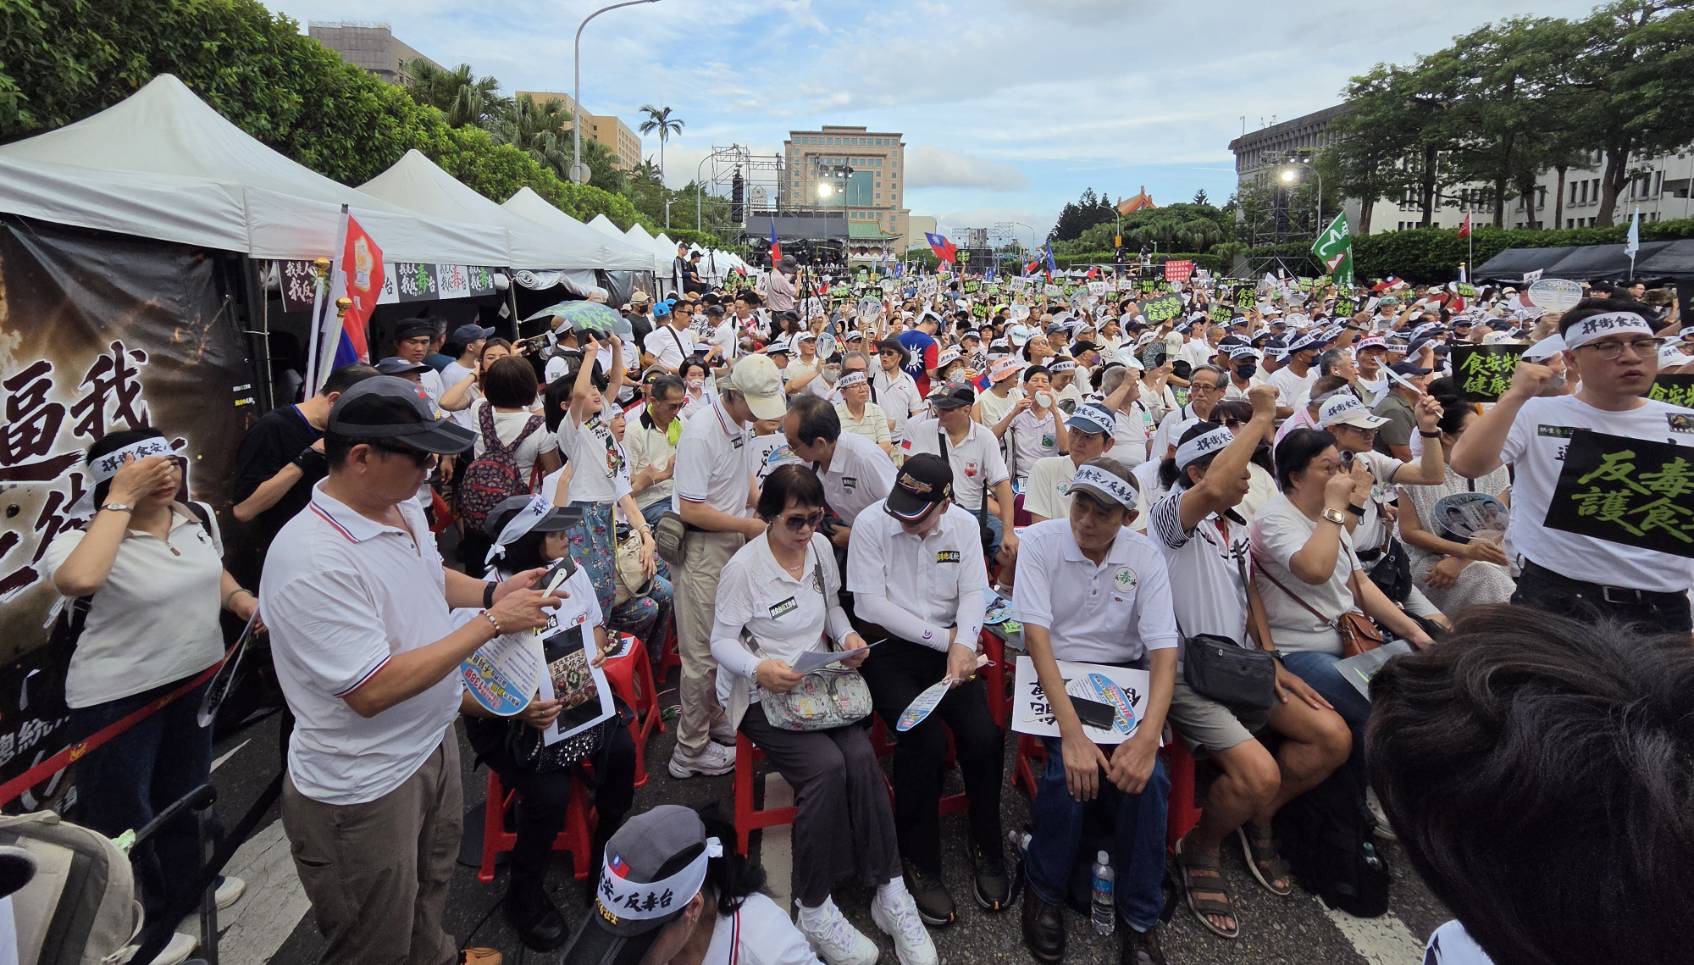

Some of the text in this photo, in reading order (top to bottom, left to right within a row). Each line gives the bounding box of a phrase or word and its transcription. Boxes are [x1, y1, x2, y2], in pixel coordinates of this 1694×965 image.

[1463, 374, 1513, 396] 健康
[1577, 449, 1694, 498] 反毒
[1571, 486, 1694, 543] 護食
